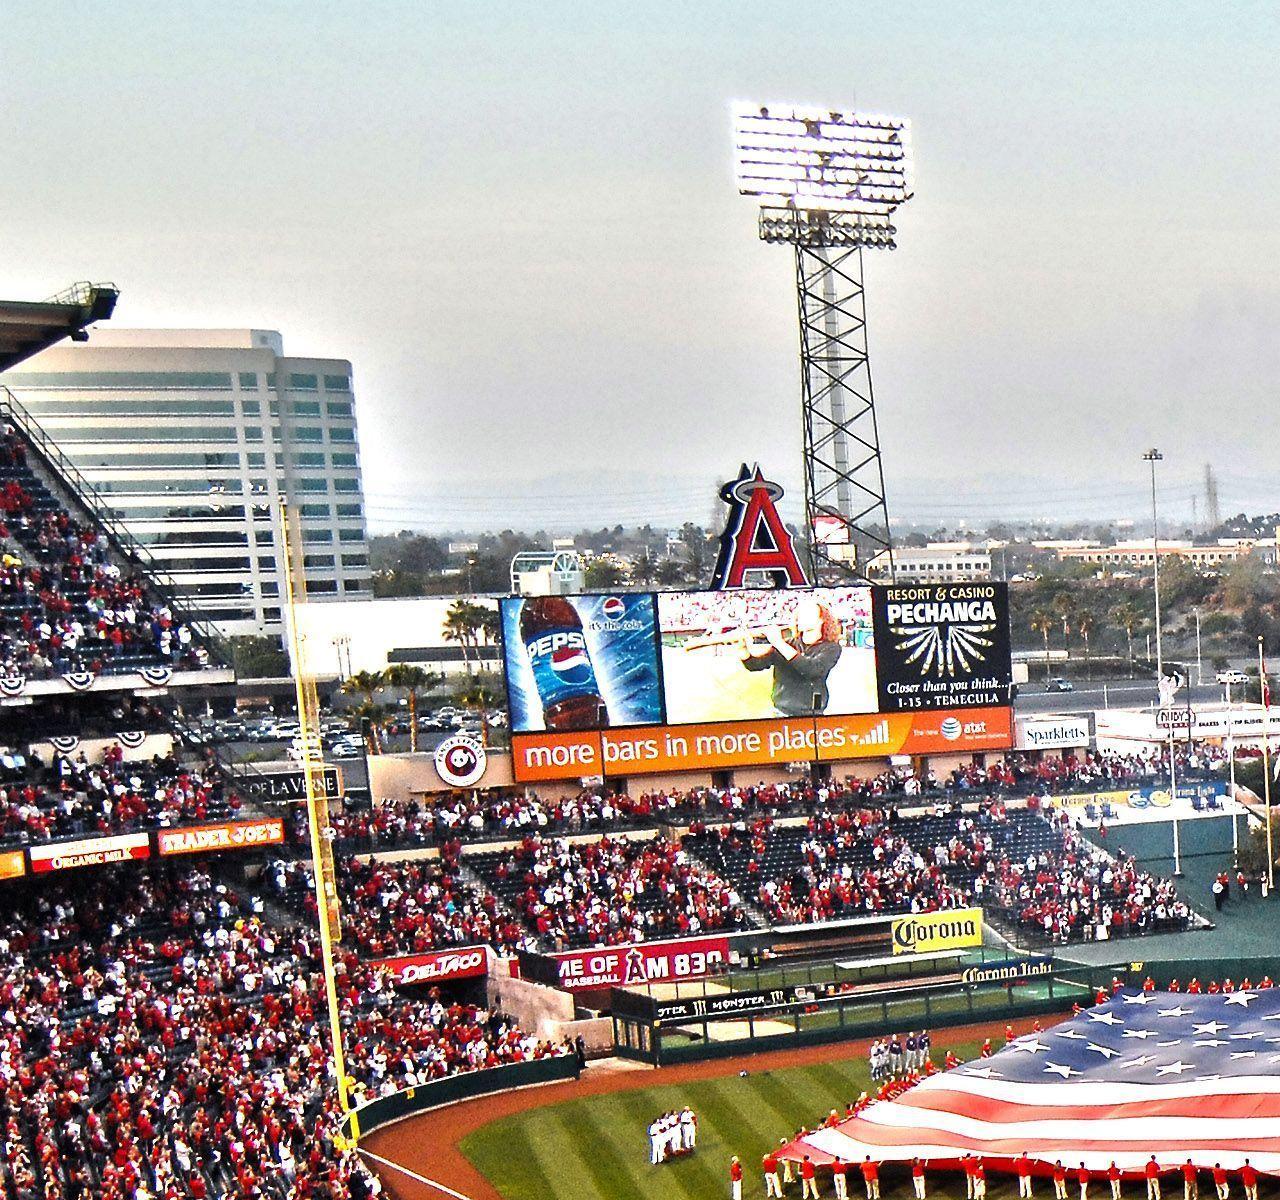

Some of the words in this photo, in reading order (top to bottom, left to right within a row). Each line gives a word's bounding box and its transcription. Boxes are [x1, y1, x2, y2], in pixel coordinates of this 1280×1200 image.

[887, 588, 931, 601] RESORT
[935, 586, 946, 601] &
[949, 587, 995, 599] CASINO
[887, 601, 997, 624] PECHANGA
[887, 682, 919, 694] Closer
[923, 680, 947, 693] than
[950, 681, 968, 693] you
[934, 693, 999, 706] TEMECULA
[1027, 725, 1086, 744] Sparkletts
[525, 744, 595, 767] more
[603, 736, 659, 762] bars
[665, 734, 688, 757] in
[697, 732, 761, 755] more
[769, 726, 846, 757] places
[271, 779, 289, 795] LA
[162, 827, 230, 851] TRADER
[231, 821, 282, 844] JOE'S
[51, 853, 104, 870] ORGANIC
[104, 847, 134, 865] MILK
[893, 919, 976, 948] Corona
[590, 955, 618, 973] OF
[565, 973, 621, 988] BASEBALL
[963, 966, 1021, 983] Corona
